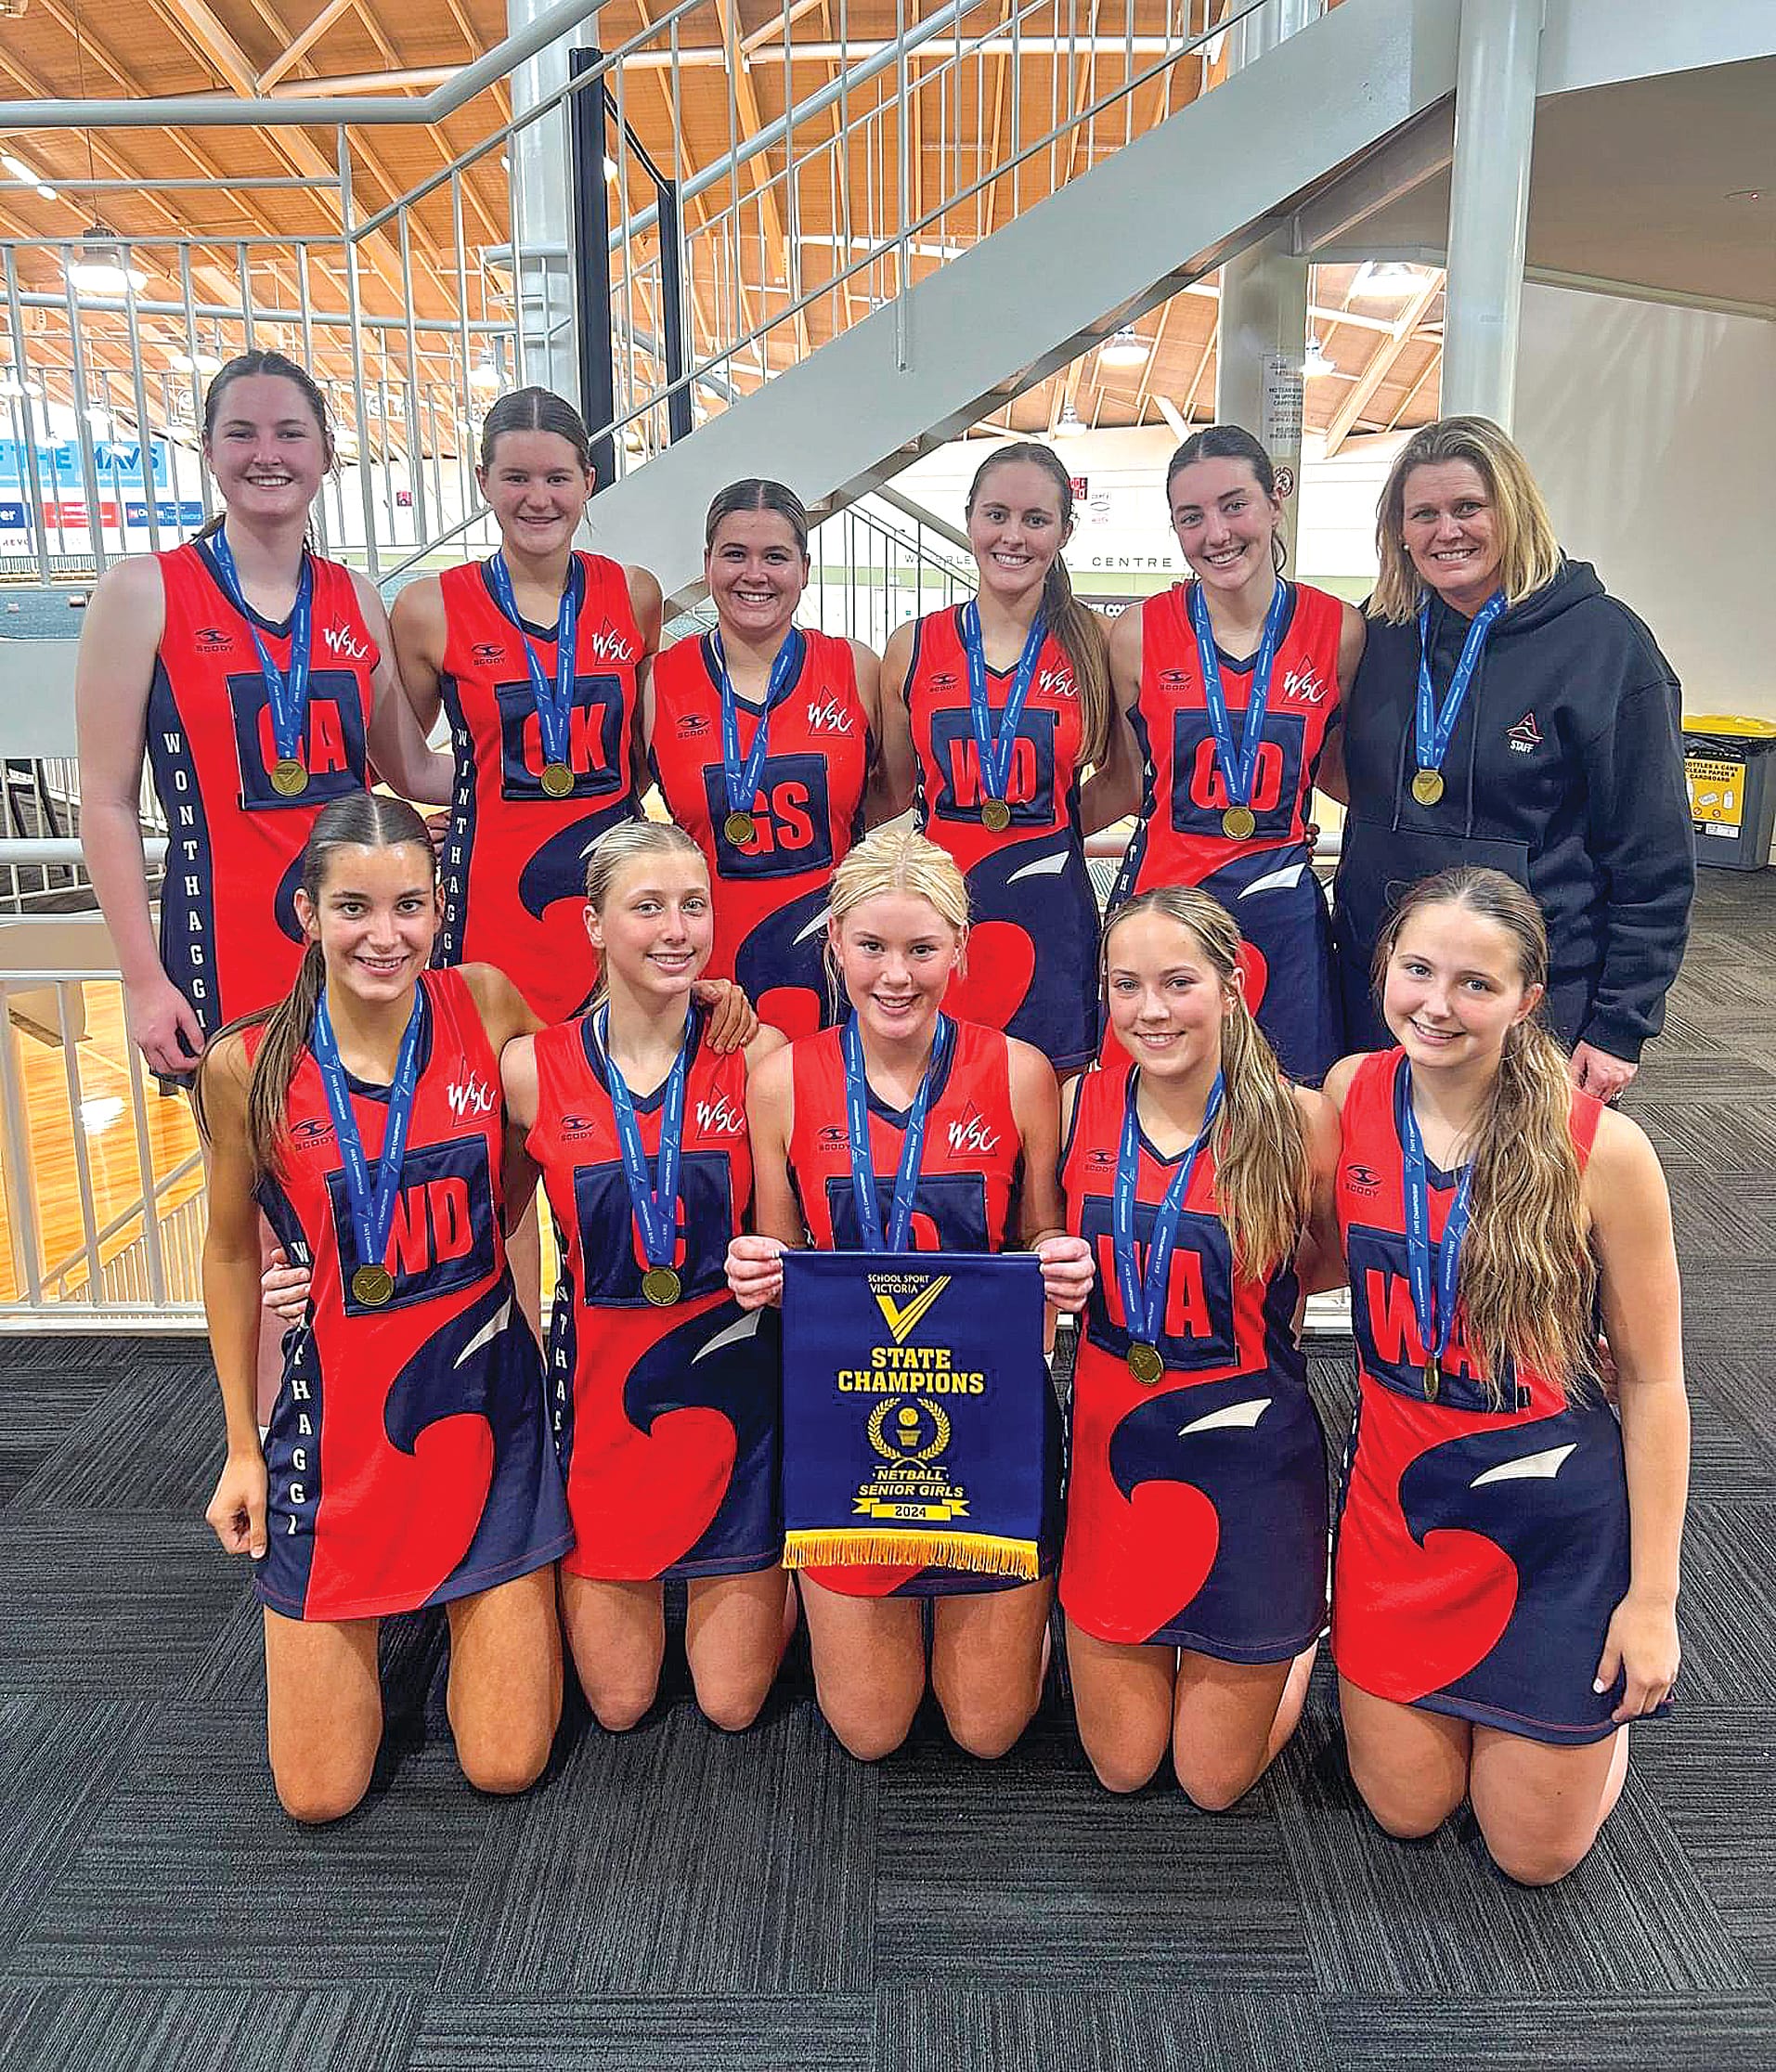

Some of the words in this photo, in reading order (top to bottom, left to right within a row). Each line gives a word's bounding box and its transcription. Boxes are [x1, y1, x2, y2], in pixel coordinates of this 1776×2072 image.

[1092, 557, 1173, 567] CENTRE
[162, 732, 207, 1029] WONTHAGGI
[867, 1274, 901, 1283] SCHOOL
[902, 1274, 929, 1284] SPORT
[869, 1284, 918, 1294] VICTORIA
[871, 1348, 952, 1369] STATE
[837, 1371, 985, 1394] CHAMPIONS
[876, 1470, 944, 1482] NETBALL
[858, 1484, 915, 1496] SENIOR
[918, 1485, 965, 1497] GIRLS
[894, 1506, 927, 1518] 2024
